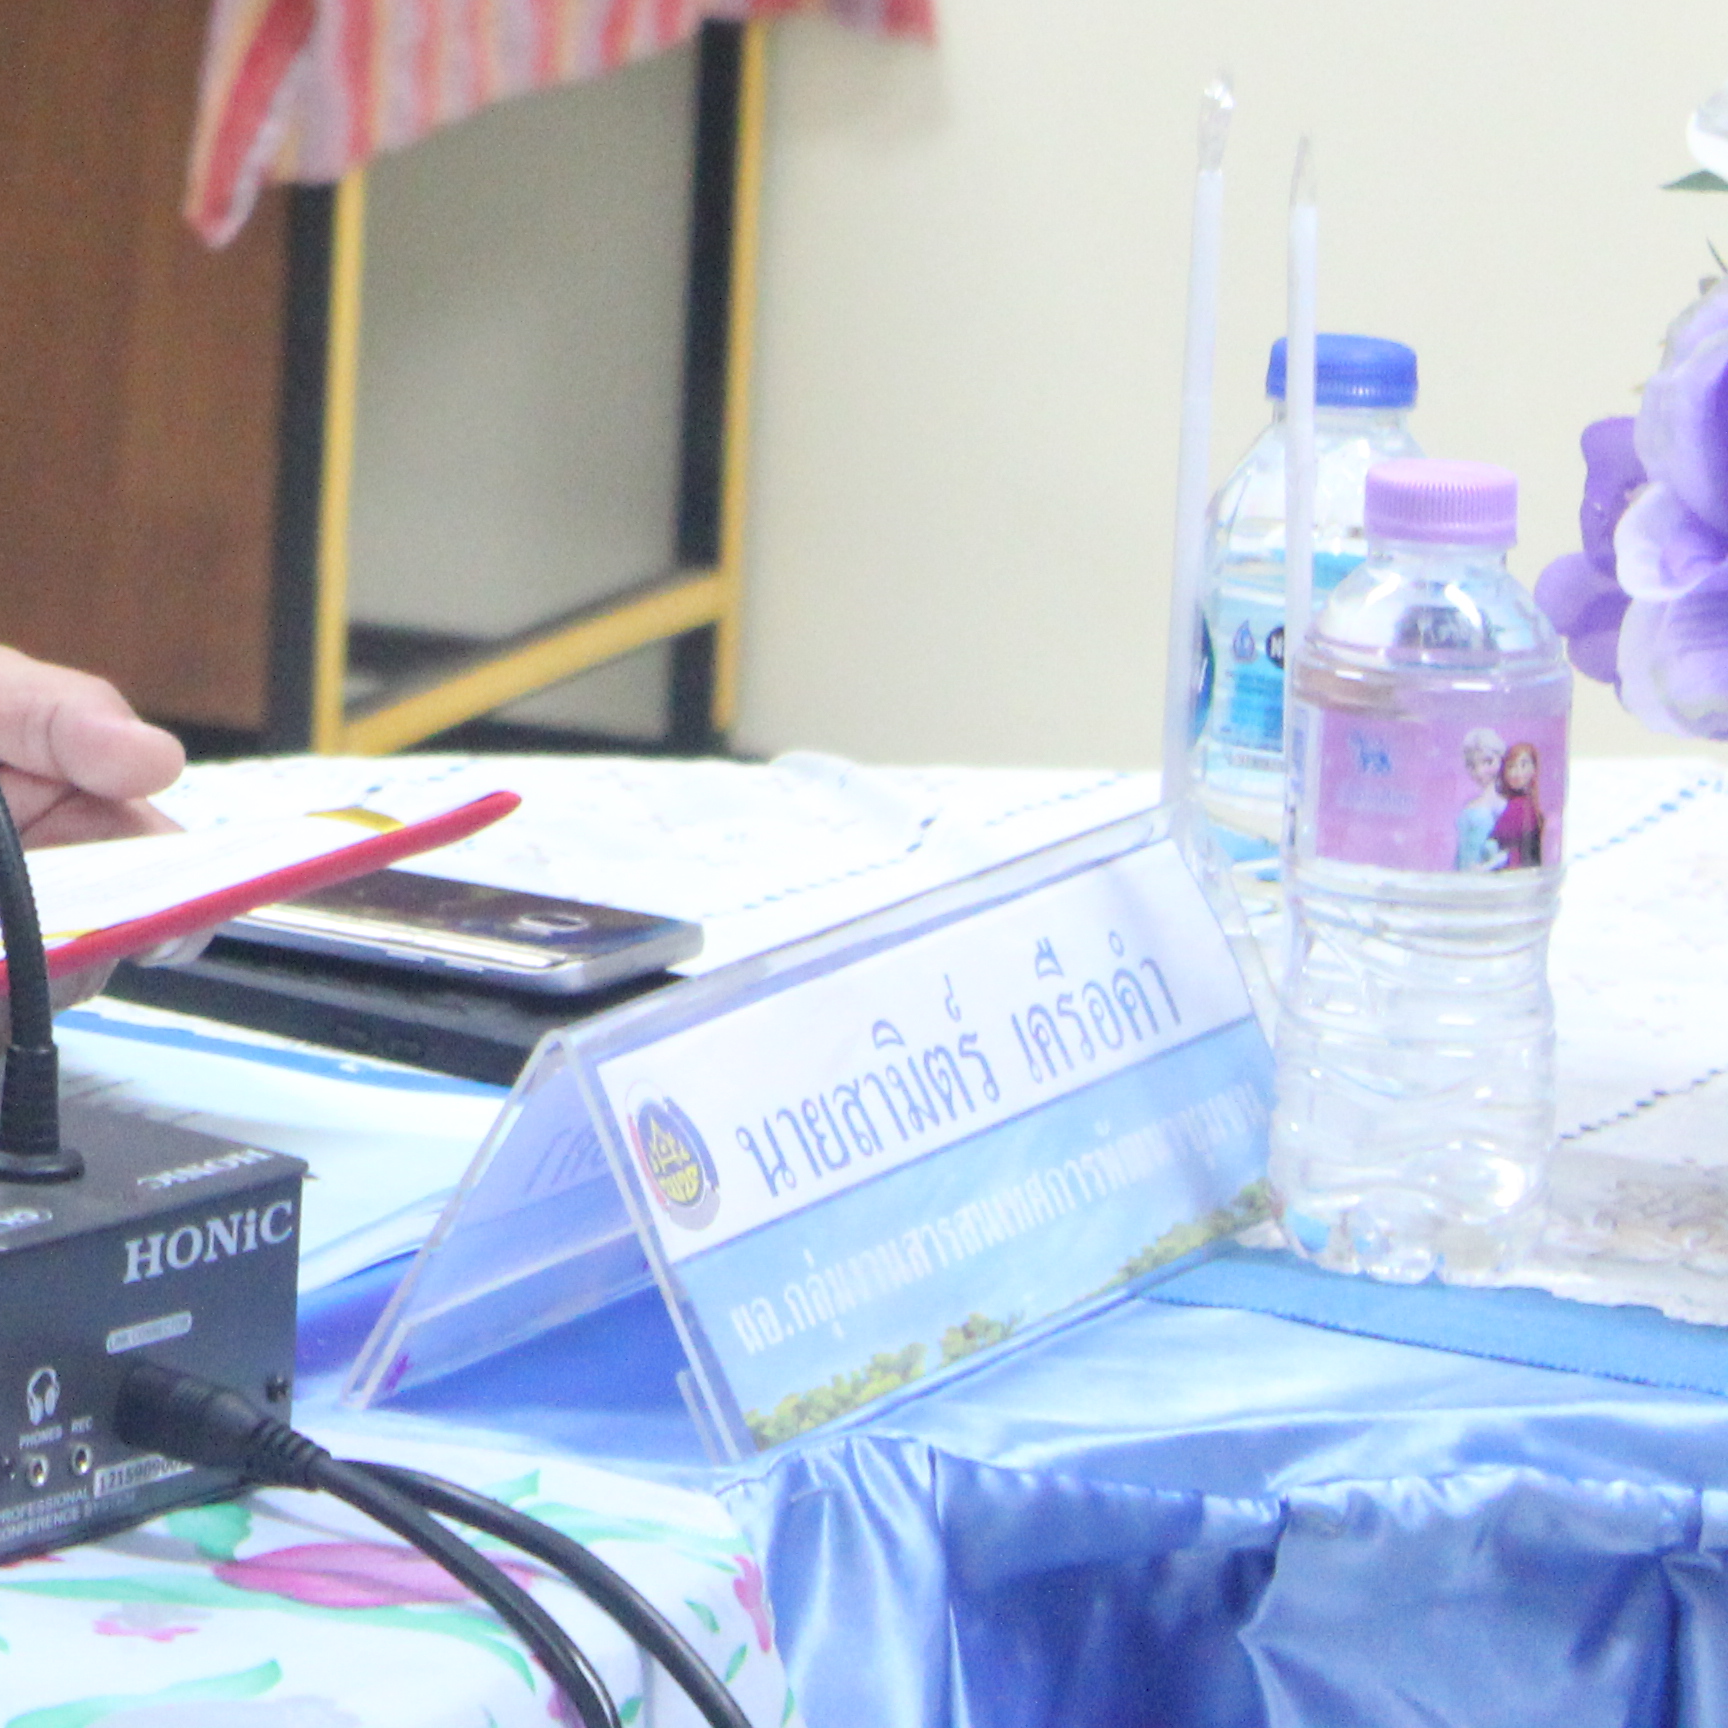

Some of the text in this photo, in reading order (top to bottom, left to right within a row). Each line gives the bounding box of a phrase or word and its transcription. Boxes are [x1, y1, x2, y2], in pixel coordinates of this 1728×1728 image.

[735, 929, 1181, 1197] นายสามิตร์ เครือคำ
